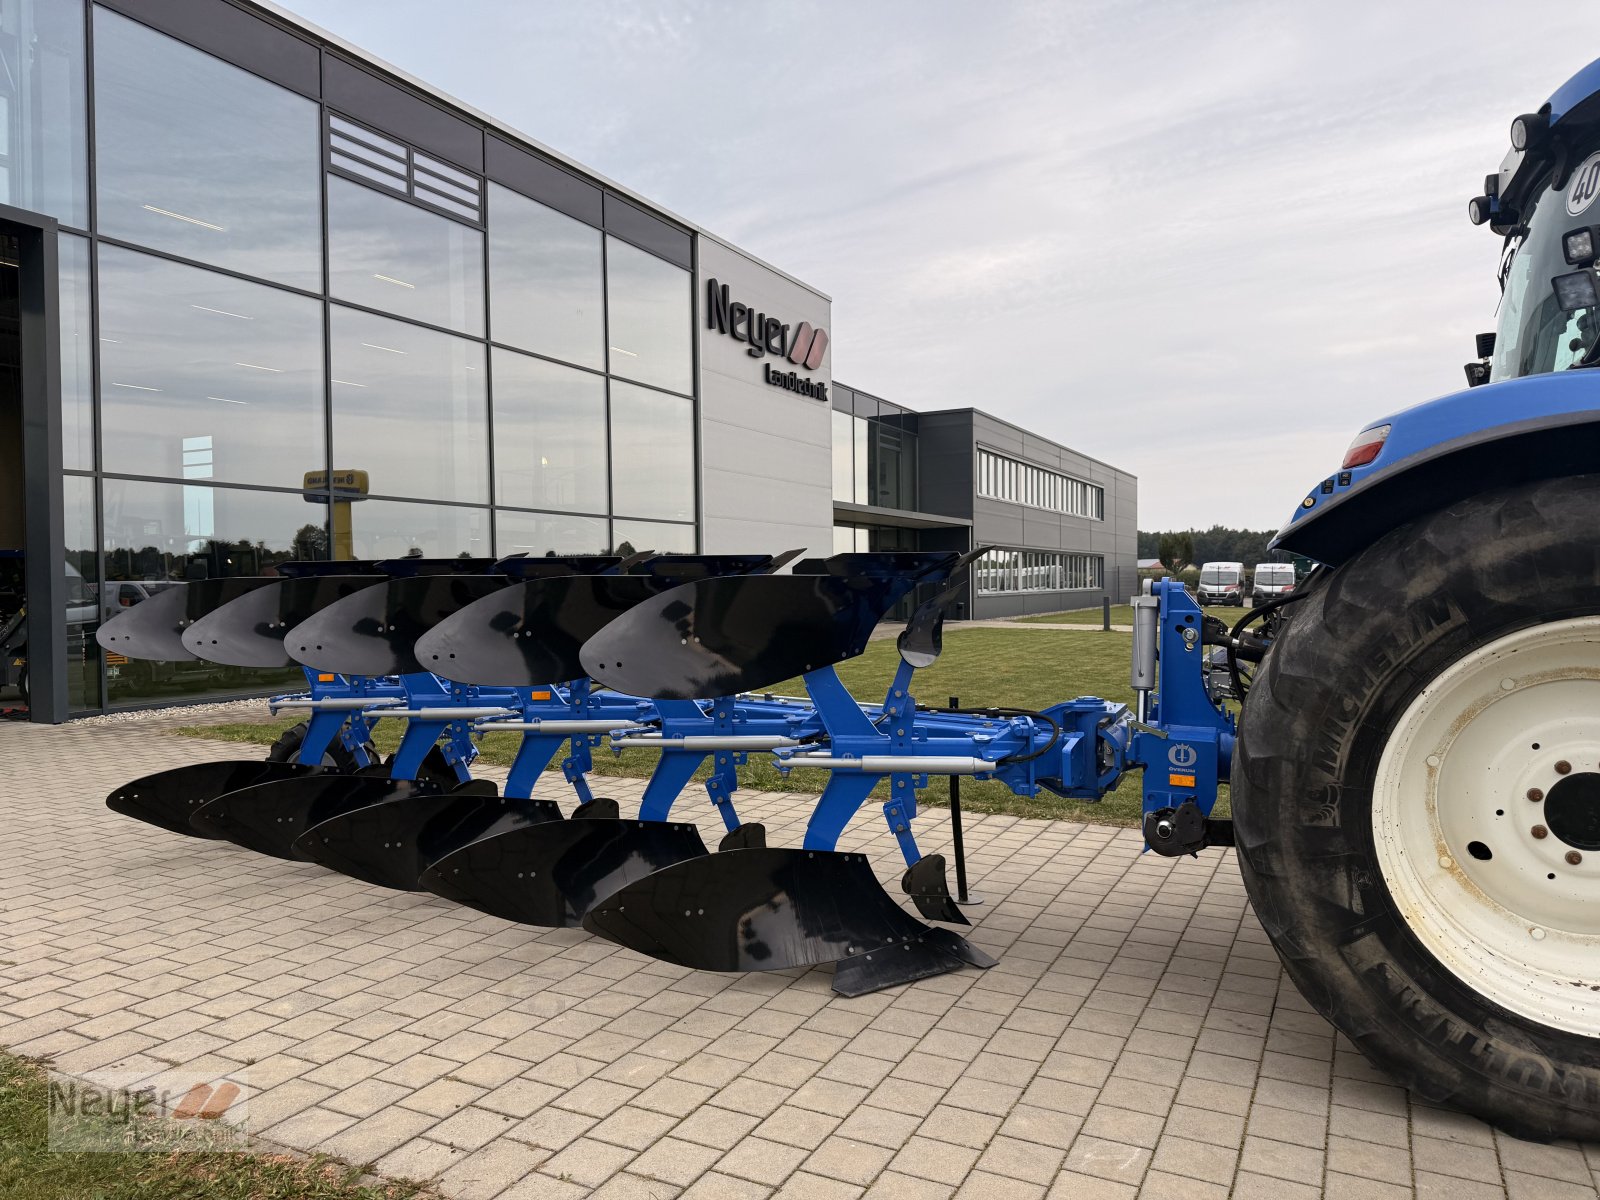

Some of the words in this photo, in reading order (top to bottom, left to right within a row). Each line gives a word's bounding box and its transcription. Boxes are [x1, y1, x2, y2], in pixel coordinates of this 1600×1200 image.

[1572, 161, 1600, 204] 40
[707, 278, 790, 358] Neyer
[764, 362, 829, 402] Landtechnik
[1311, 595, 1455, 783] MICHELIN
